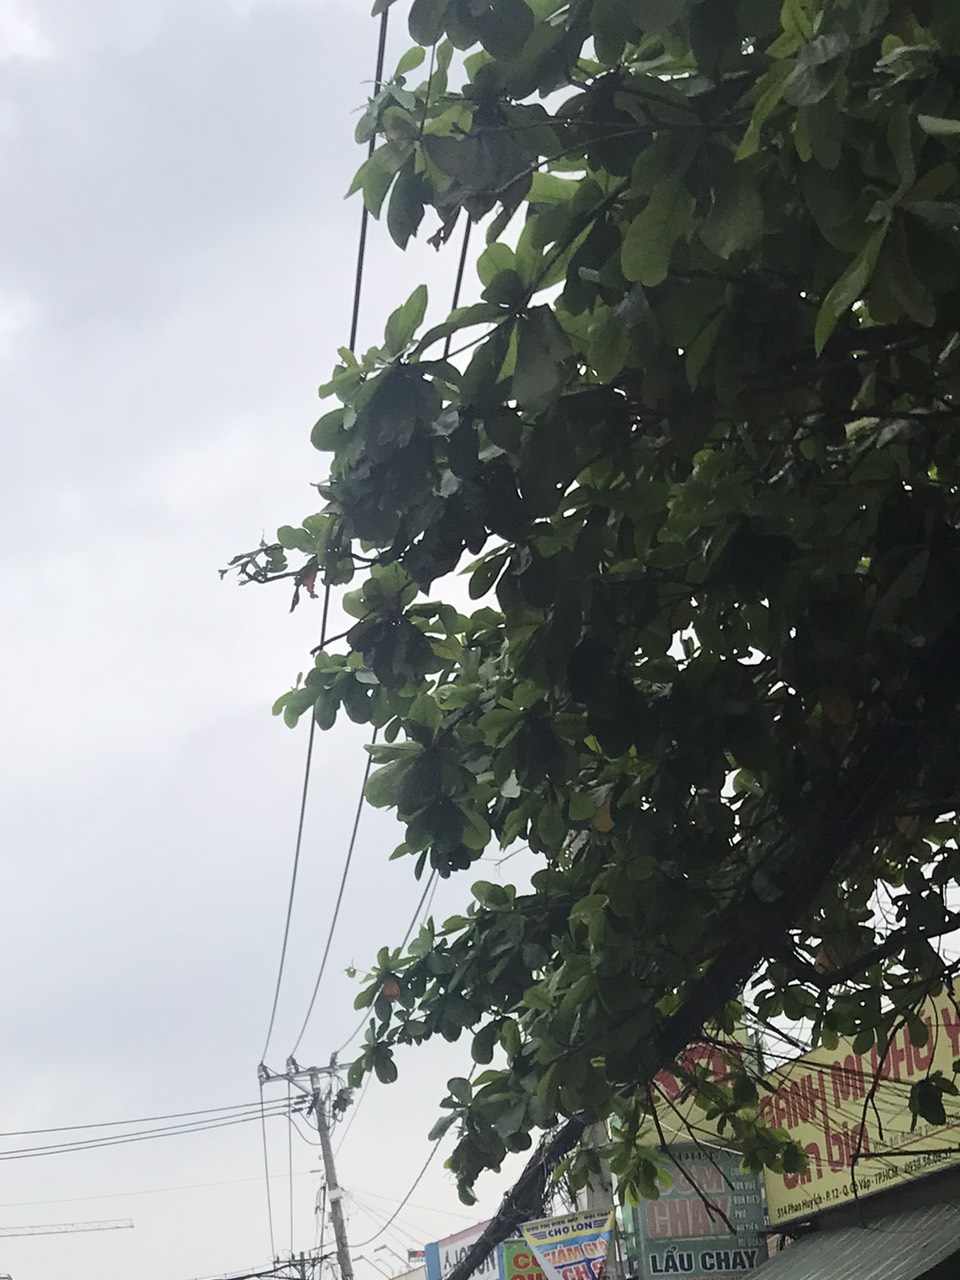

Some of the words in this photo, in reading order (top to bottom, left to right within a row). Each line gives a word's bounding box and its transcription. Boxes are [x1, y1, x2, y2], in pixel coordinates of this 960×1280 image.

[646, 1196, 731, 1240] CHAY
[650, 1246, 694, 1274] LẨU
[700, 1249, 757, 1271] CHAY
